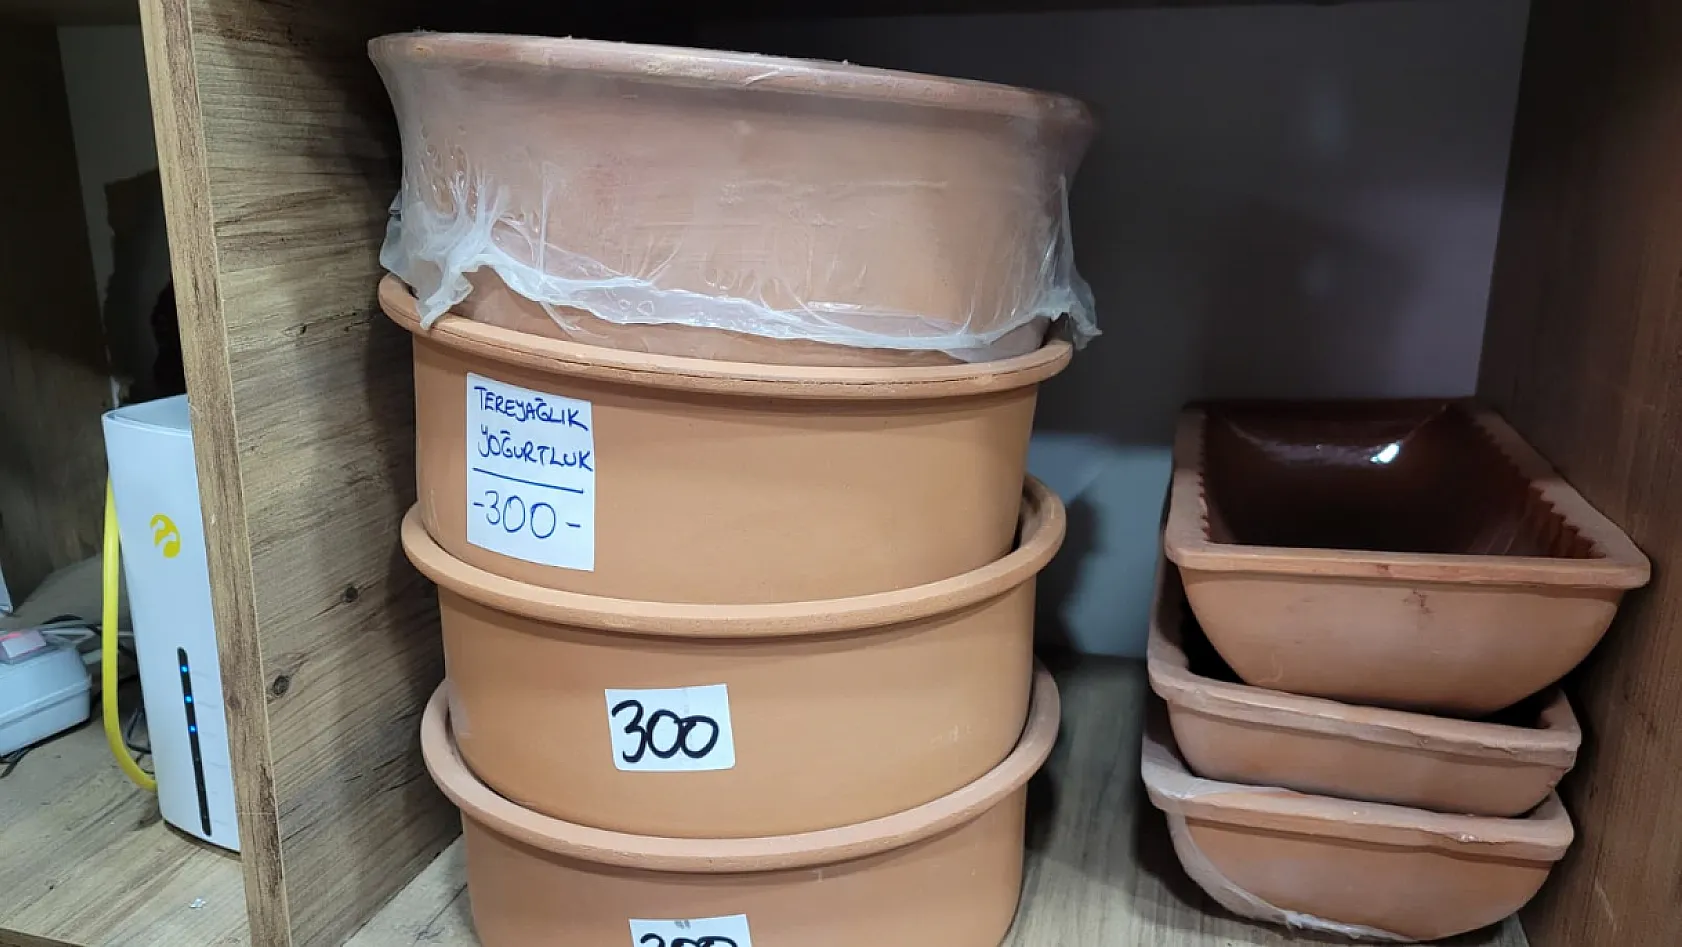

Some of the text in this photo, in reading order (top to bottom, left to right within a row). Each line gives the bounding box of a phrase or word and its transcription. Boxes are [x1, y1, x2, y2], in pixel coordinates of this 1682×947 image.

[473, 385, 590, 432] TEREYAĞLIK
[477, 423, 594, 472] YOĞURTLUK
[611, 699, 719, 763] 300
